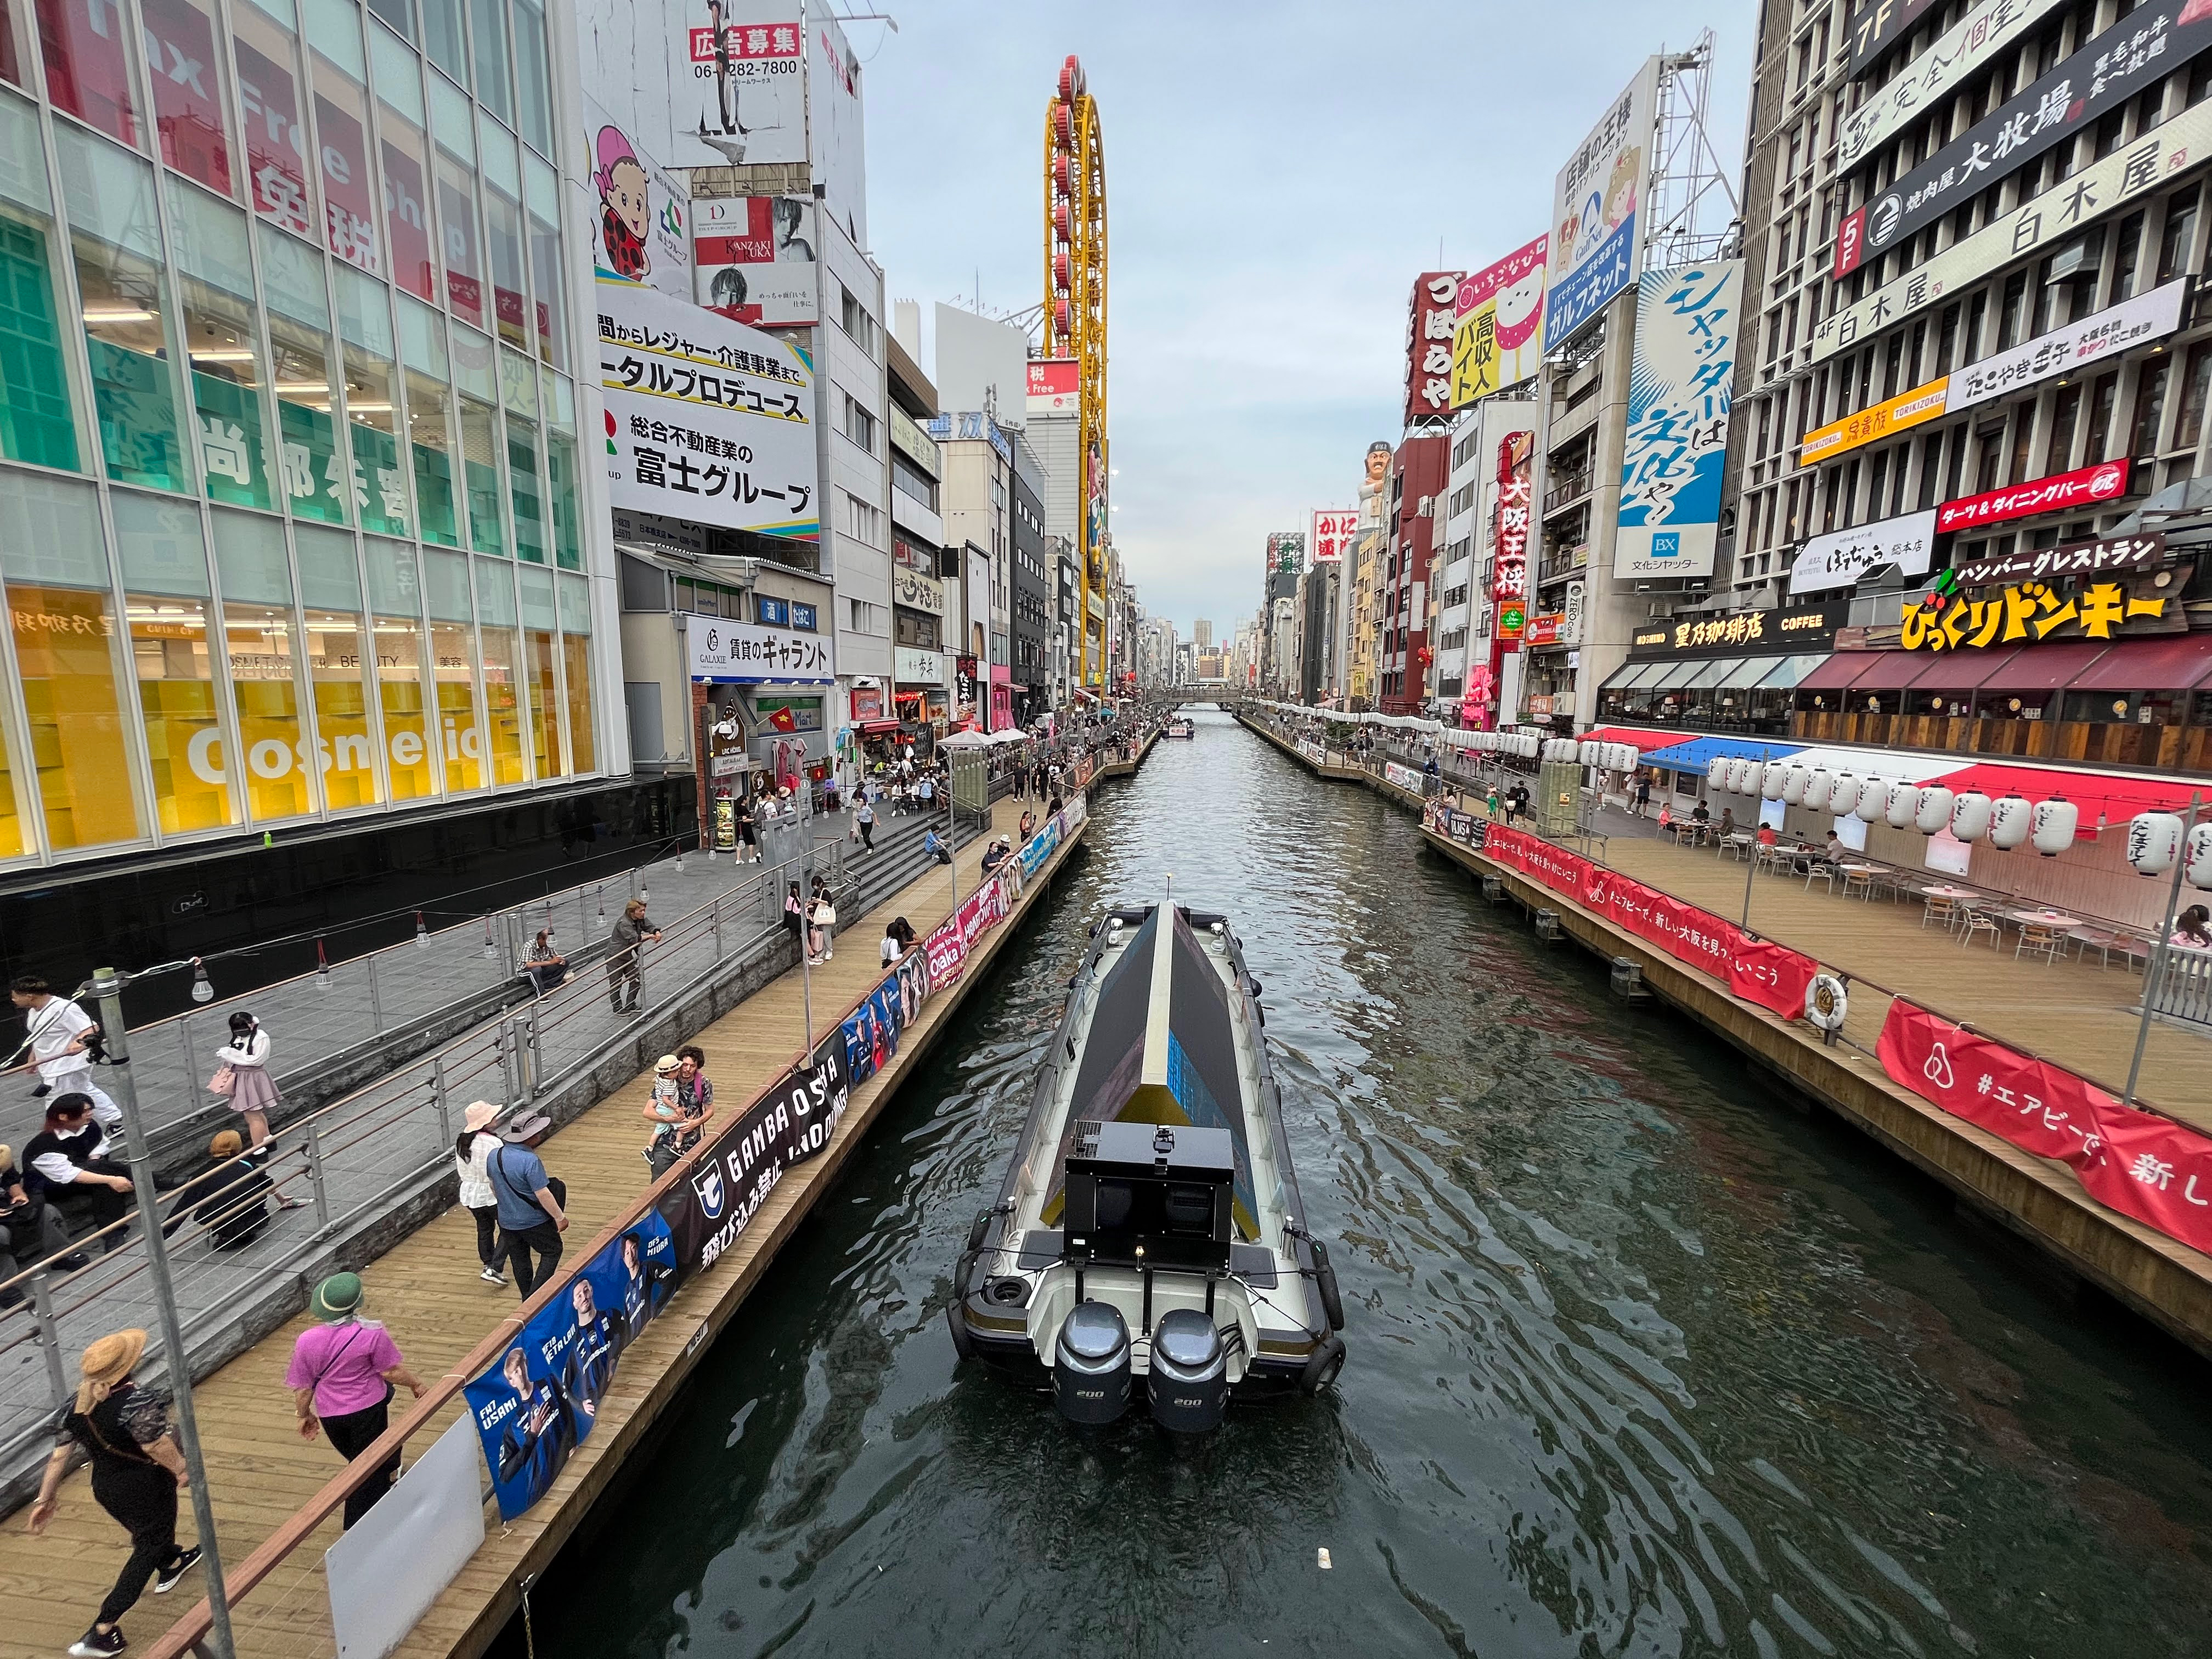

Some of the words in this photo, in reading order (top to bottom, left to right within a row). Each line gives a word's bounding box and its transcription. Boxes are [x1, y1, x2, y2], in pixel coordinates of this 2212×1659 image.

[695, 27, 795, 58] 広告募集
[1857, 1, 1892, 57] 7F
[2092, 14, 2169, 78] 黒毛和牛
[695, 60, 797, 78] 06-282-7800
[2089, 32, 2168, 99] 食べ放題
[1565, 91, 1632, 195] 店舗の王様
[1905, 166, 1955, 214] 焼肉屋
[1956, 79, 2074, 187] 大牧場
[255, 166, 379, 270] 免税
[2012, 140, 2161, 256] 白木屋
[725, 239, 771, 254] KANZAKI
[743, 248, 771, 261] RUKA
[1841, 217, 1859, 272] 5F
[1475, 249, 1535, 294] いちごなび
[1549, 253, 1627, 343] ガルフネット
[1818, 323, 1834, 342] 4F
[1838, 273, 1927, 346] 白木屋
[1456, 318, 1477, 403] バイト
[1033, 384, 1054, 393] Free
[630, 414, 753, 464] 総合不動産業の
[634, 445, 811, 514] 富士グループ
[1942, 507, 1976, 524] ダーツ
[1978, 501, 1989, 516] &
[1992, 479, 2089, 514] ダイニングバー
[1318, 516, 1357, 535] かに
[1496, 475, 1531, 596] 大阪王将
[1655, 538, 1677, 551] BX
[1795, 544, 1805, 555] 2F
[1956, 539, 2155, 583] ハンバーグレストラン
[767, 601, 776, 621] 酒
[793, 607, 810, 626] たばこ
[1637, 633, 1666, 645] HOSHINO
[1675, 612, 1766, 648] 星乃珈琲店
[1781, 614, 1824, 632] COFFEE
[1901, 582, 2165, 651] びっくりドンキー
[340, 656, 399, 668] BETY
[439, 656, 462, 668] 美容
[699, 654, 727, 664] GALAXIE
[730, 635, 827, 671] 賃貸のギャラント
[188, 718, 479, 785] Cosmeic
[930, 947, 960, 977] Oaka
[726, 1101, 789, 1183] GAMBA
[792, 1054, 838, 1116] OSKA
[699, 1155, 782, 1273] 飛び込み禁止
[647, 1237, 668, 1256] MIURA
[479, 1400, 496, 1419] FW7
[482, 1397, 517, 1430] USAMI
[1076, 1390, 1104, 1398] 200
[1174, 1398, 1201, 1407] 200
